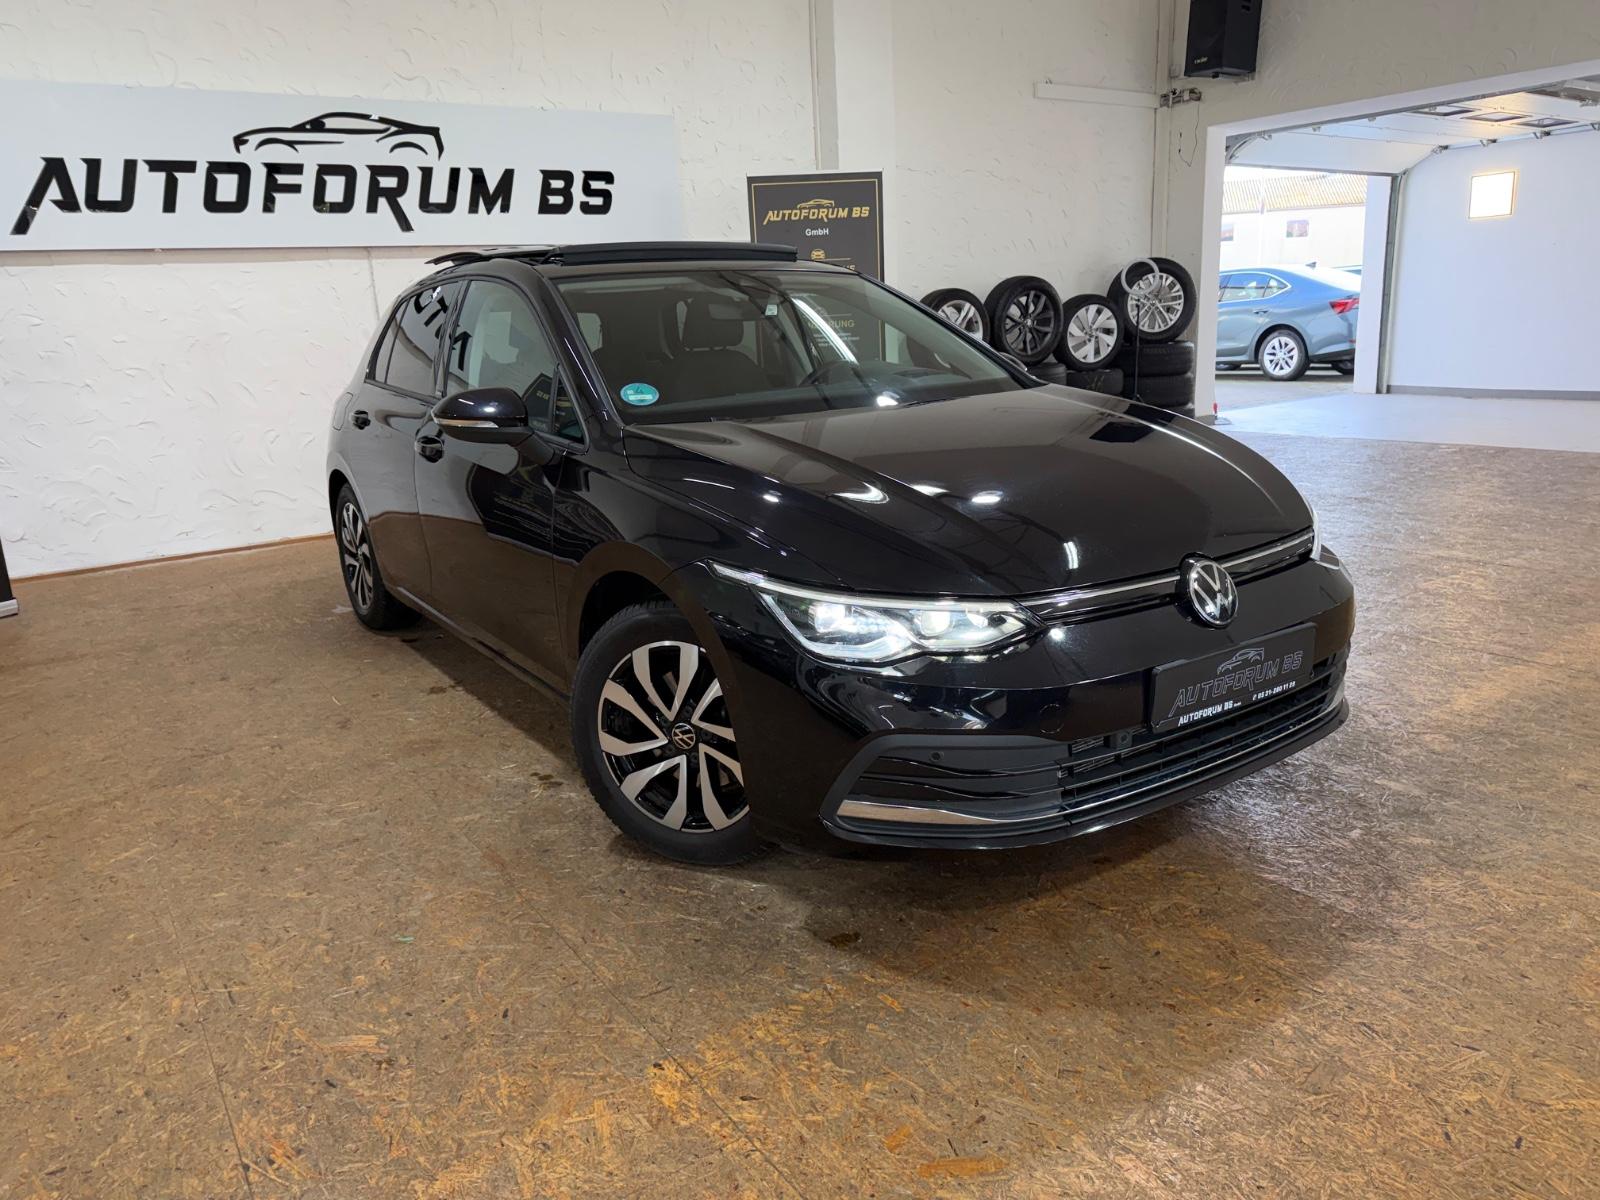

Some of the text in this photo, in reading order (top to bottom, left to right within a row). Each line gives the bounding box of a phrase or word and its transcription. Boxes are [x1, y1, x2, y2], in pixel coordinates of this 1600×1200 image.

[9, 156, 616, 235] AUTOFORUM BS
[762, 206, 870, 226] AUTOFORUM BS
[805, 228, 829, 237] GmbH
[1168, 650, 1304, 718] AUTOFORUM BS
[1178, 703, 1223, 727] AUTOFORUM
